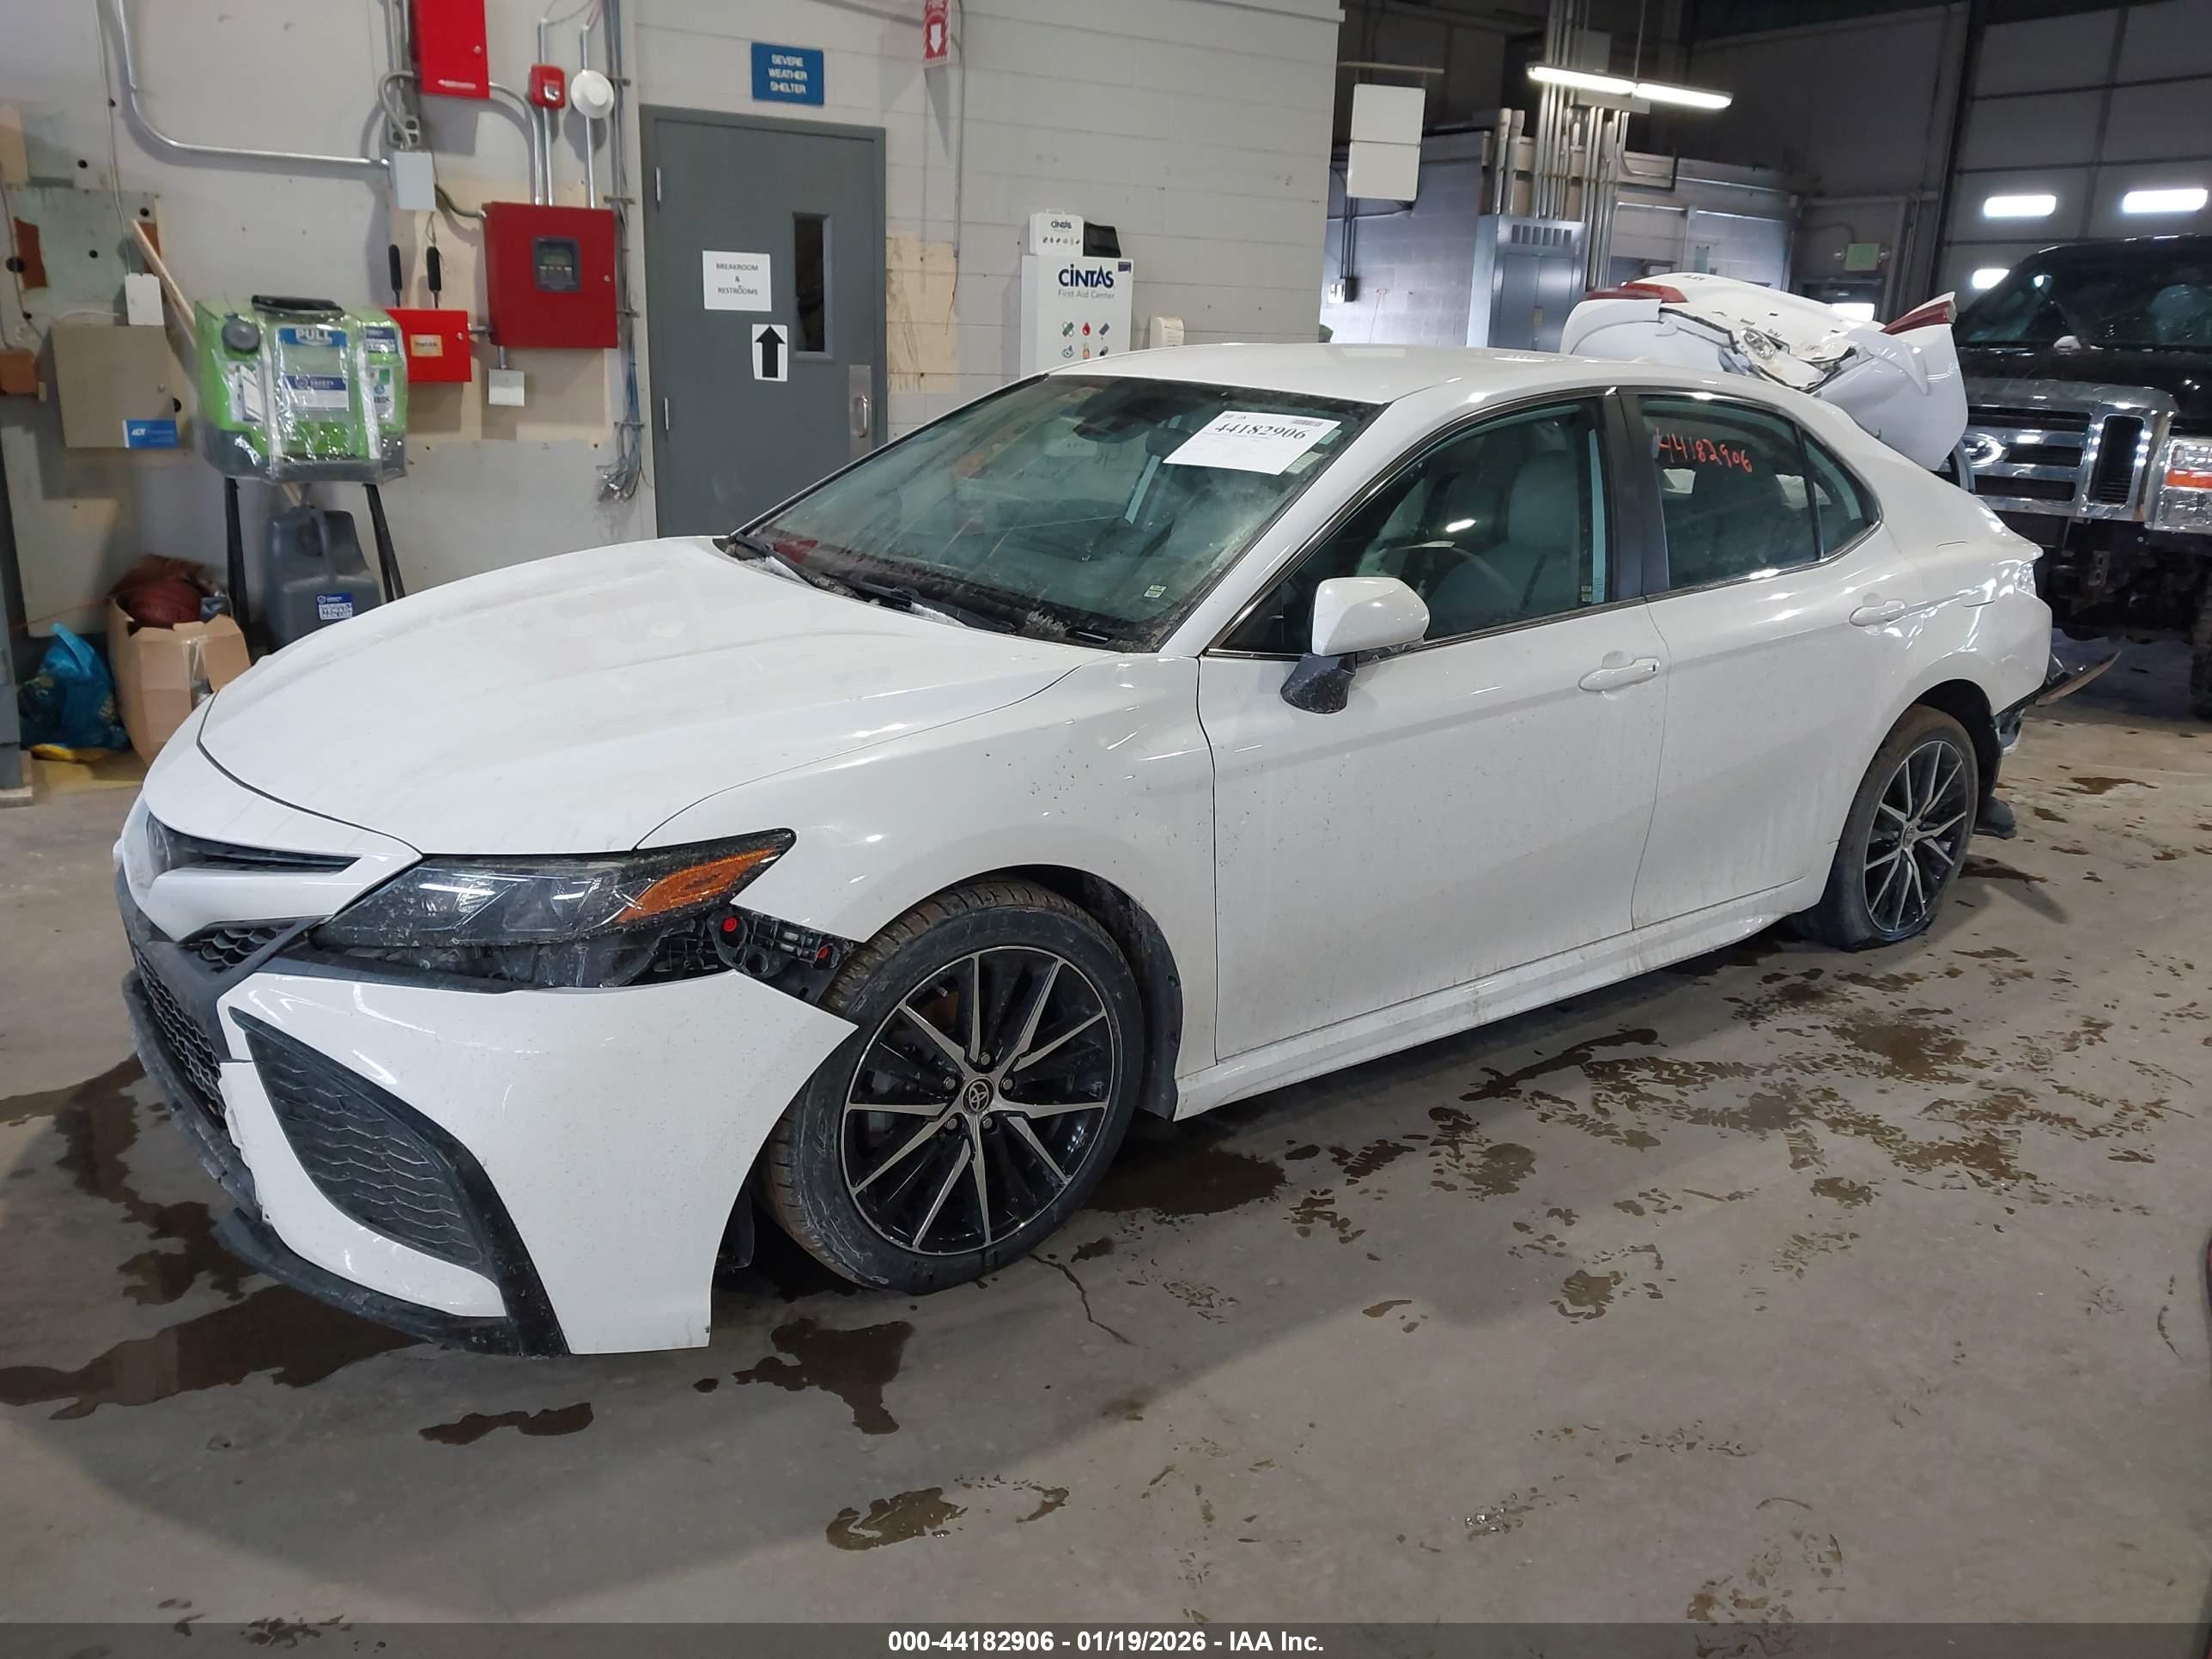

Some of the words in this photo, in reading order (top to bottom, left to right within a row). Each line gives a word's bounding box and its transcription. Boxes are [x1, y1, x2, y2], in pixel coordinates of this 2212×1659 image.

[771, 54, 804, 67] SEVERE
[768, 68, 807, 81] WEATHER
[769, 81, 806, 94] SHELTER
[715, 263, 758, 271] BREAKROOM
[717, 287, 758, 296] RESTROOMS
[1058, 289, 1074, 297] First
[1076, 290, 1089, 299] Aid
[1091, 290, 1115, 300] Center
[295, 328, 332, 341] PULL
[1214, 422, 1310, 441] 44182906
[1656, 427, 1753, 473] 44182906
